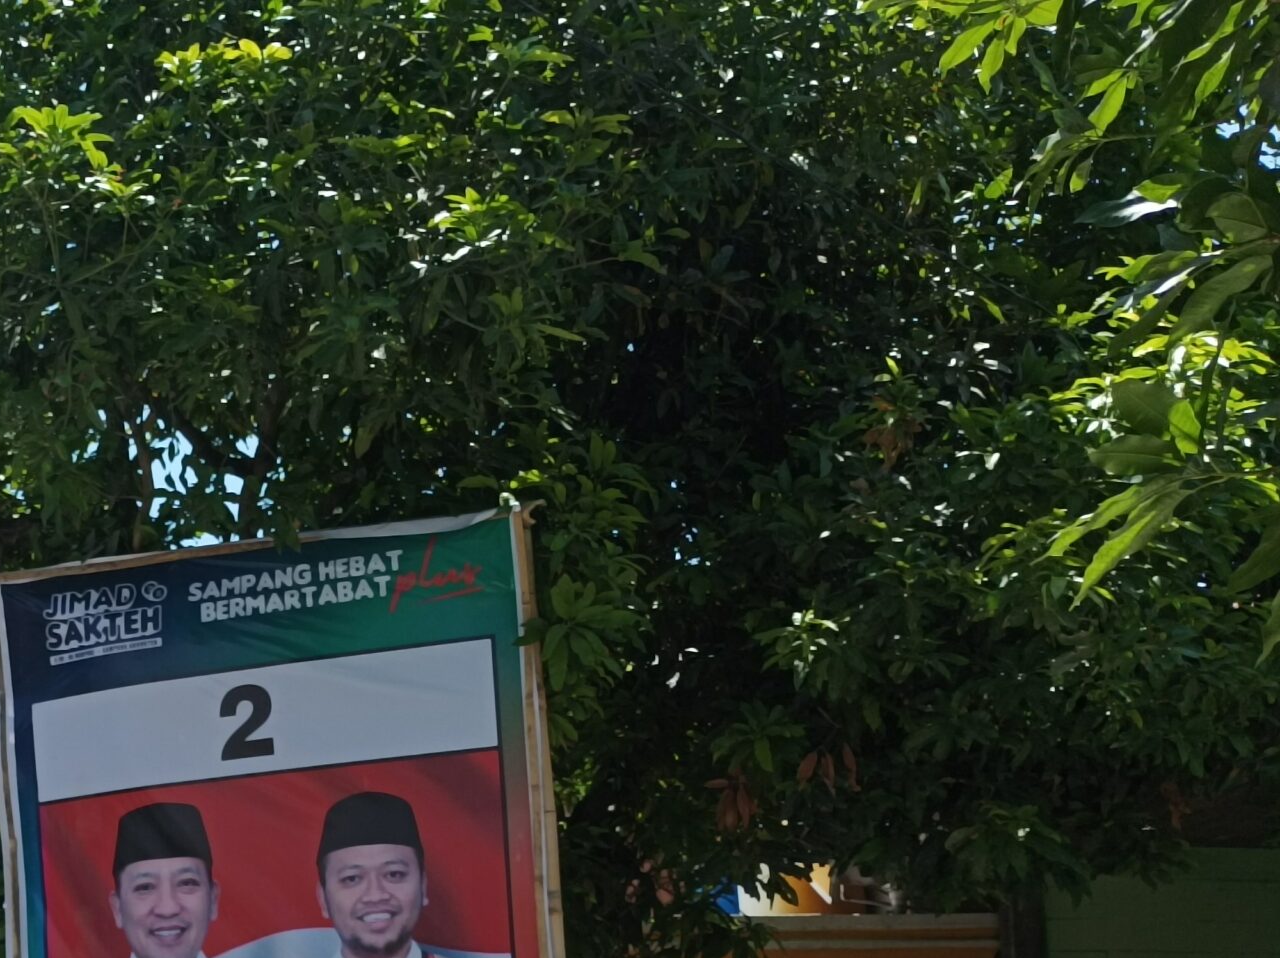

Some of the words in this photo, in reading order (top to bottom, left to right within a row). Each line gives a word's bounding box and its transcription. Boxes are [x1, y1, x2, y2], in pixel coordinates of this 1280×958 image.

[188, 563, 312, 601] SAMPANG
[318, 549, 403, 581] HEBAT
[200, 575, 391, 623] BERMARTABAT
[43, 583, 137, 620] JIMAD
[46, 605, 162, 651] SAKTEH
[219, 683, 275, 761] 2
